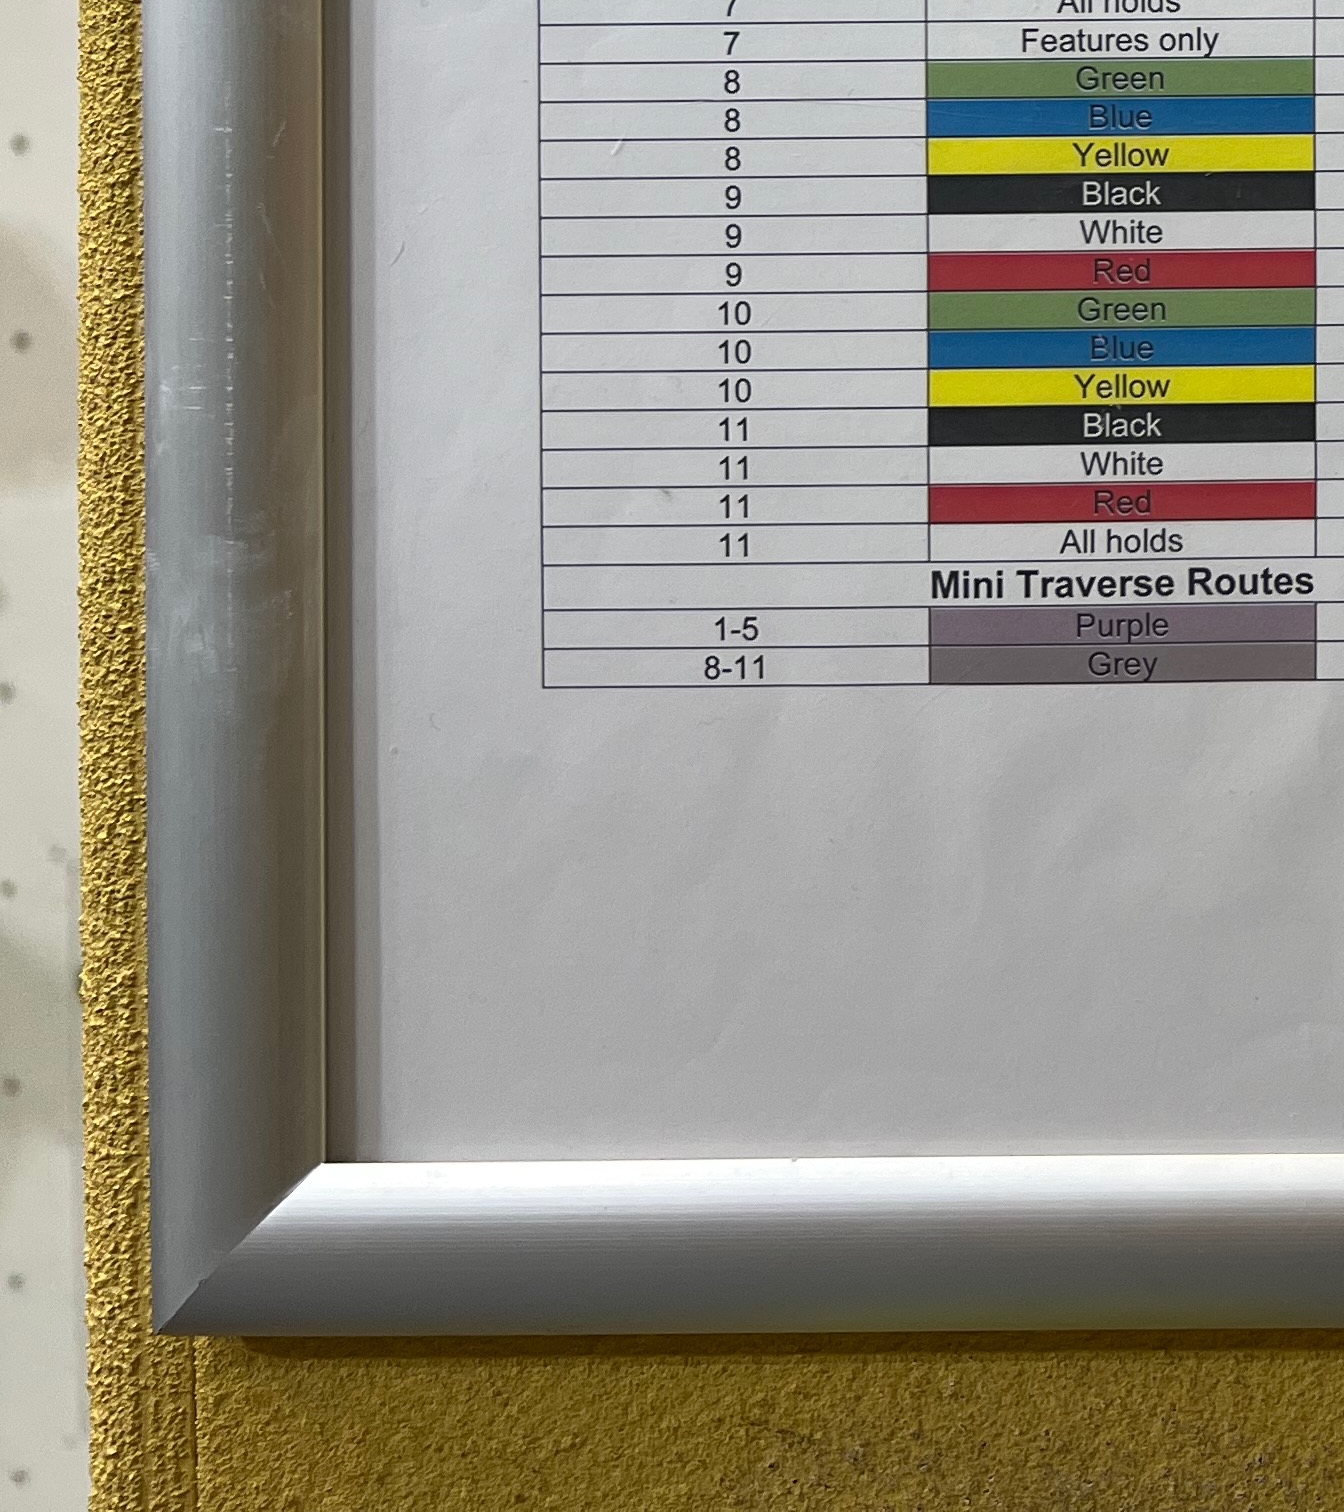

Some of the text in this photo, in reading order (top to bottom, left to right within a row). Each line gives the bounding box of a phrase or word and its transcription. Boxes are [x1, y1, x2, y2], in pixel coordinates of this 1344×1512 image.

[723, 31, 741, 56] 7
[1021, 27, 1219, 60] Features only
[725, 185, 742, 210] 9
[1082, 180, 1161, 206] Black
[719, 416, 748, 442] 11
[1083, 412, 1162, 438] Black
[931, 567, 1314, 599] Mini Traverse Routes
[714, 616, 759, 641] 1-5
[1074, 612, 1170, 642] Purple
[704, 654, 764, 681] 8-11
[1086, 652, 1159, 683] Grey
